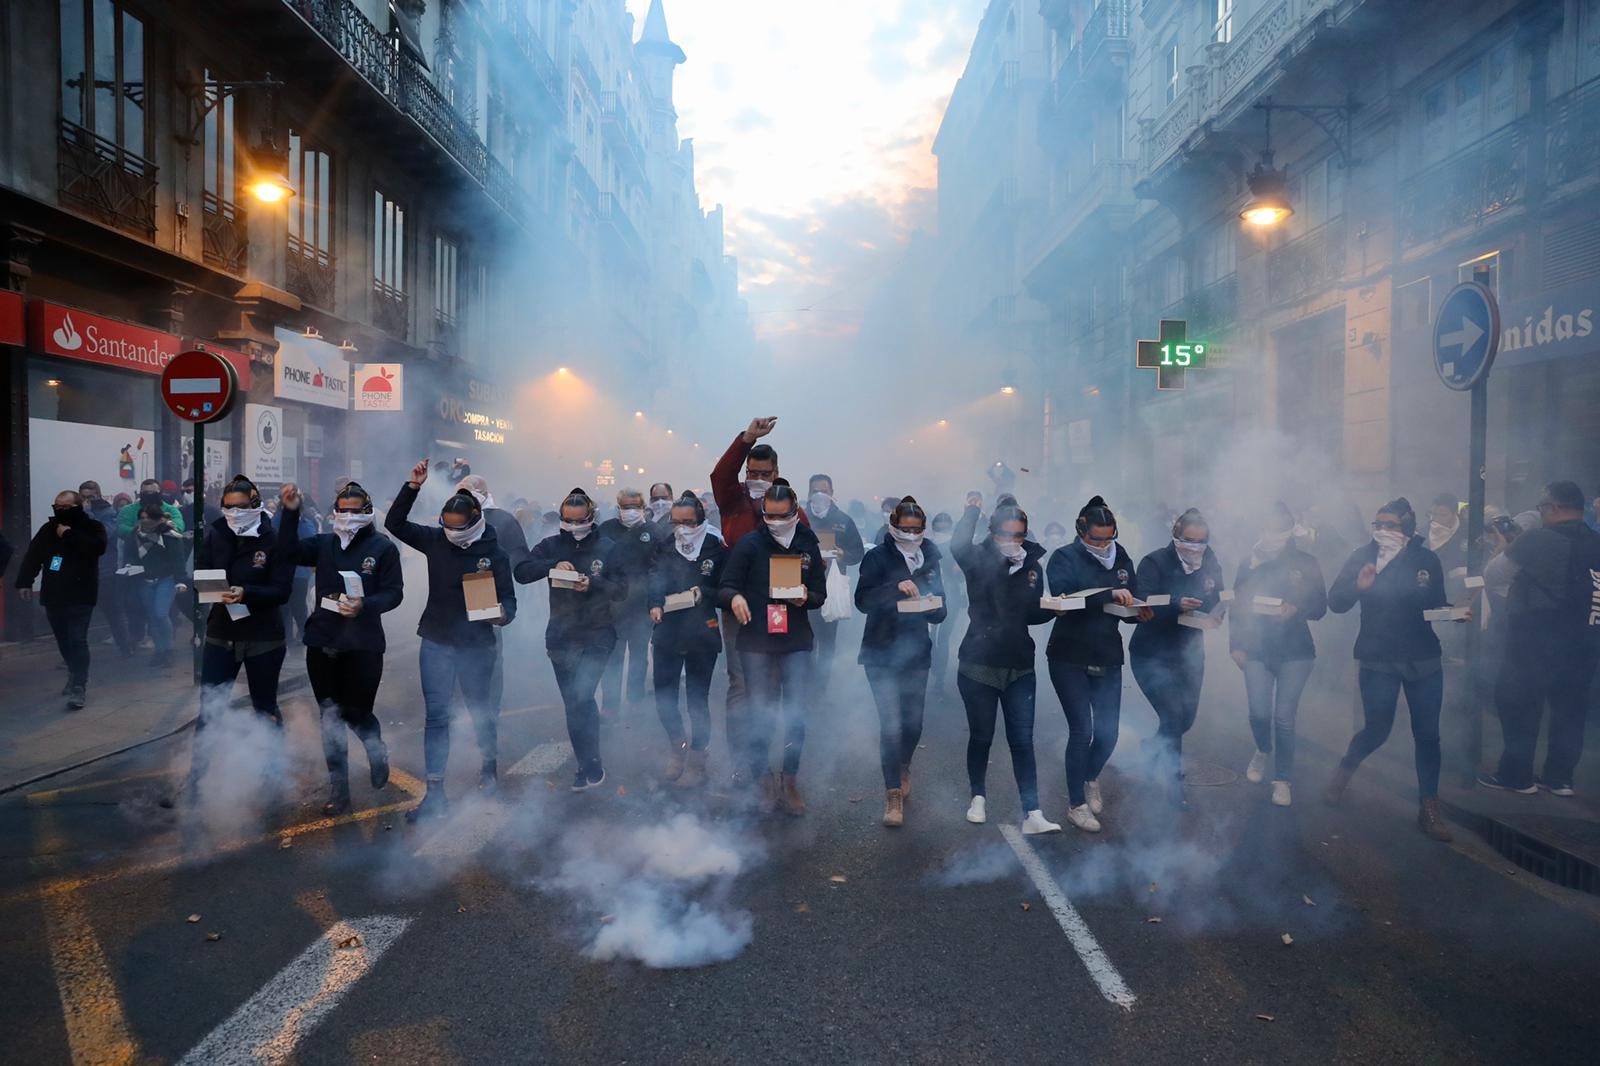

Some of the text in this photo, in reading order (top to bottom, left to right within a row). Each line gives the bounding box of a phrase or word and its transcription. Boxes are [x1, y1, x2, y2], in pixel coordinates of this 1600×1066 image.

[1497, 305, 1593, 352] nidas
[86, 325, 175, 368] Santander
[1160, 344, 1204, 366] 15°
[284, 367, 311, 385] PHONE
[325, 376, 347, 393] TASTIC
[362, 392, 392, 408] PHONE TASTIC
